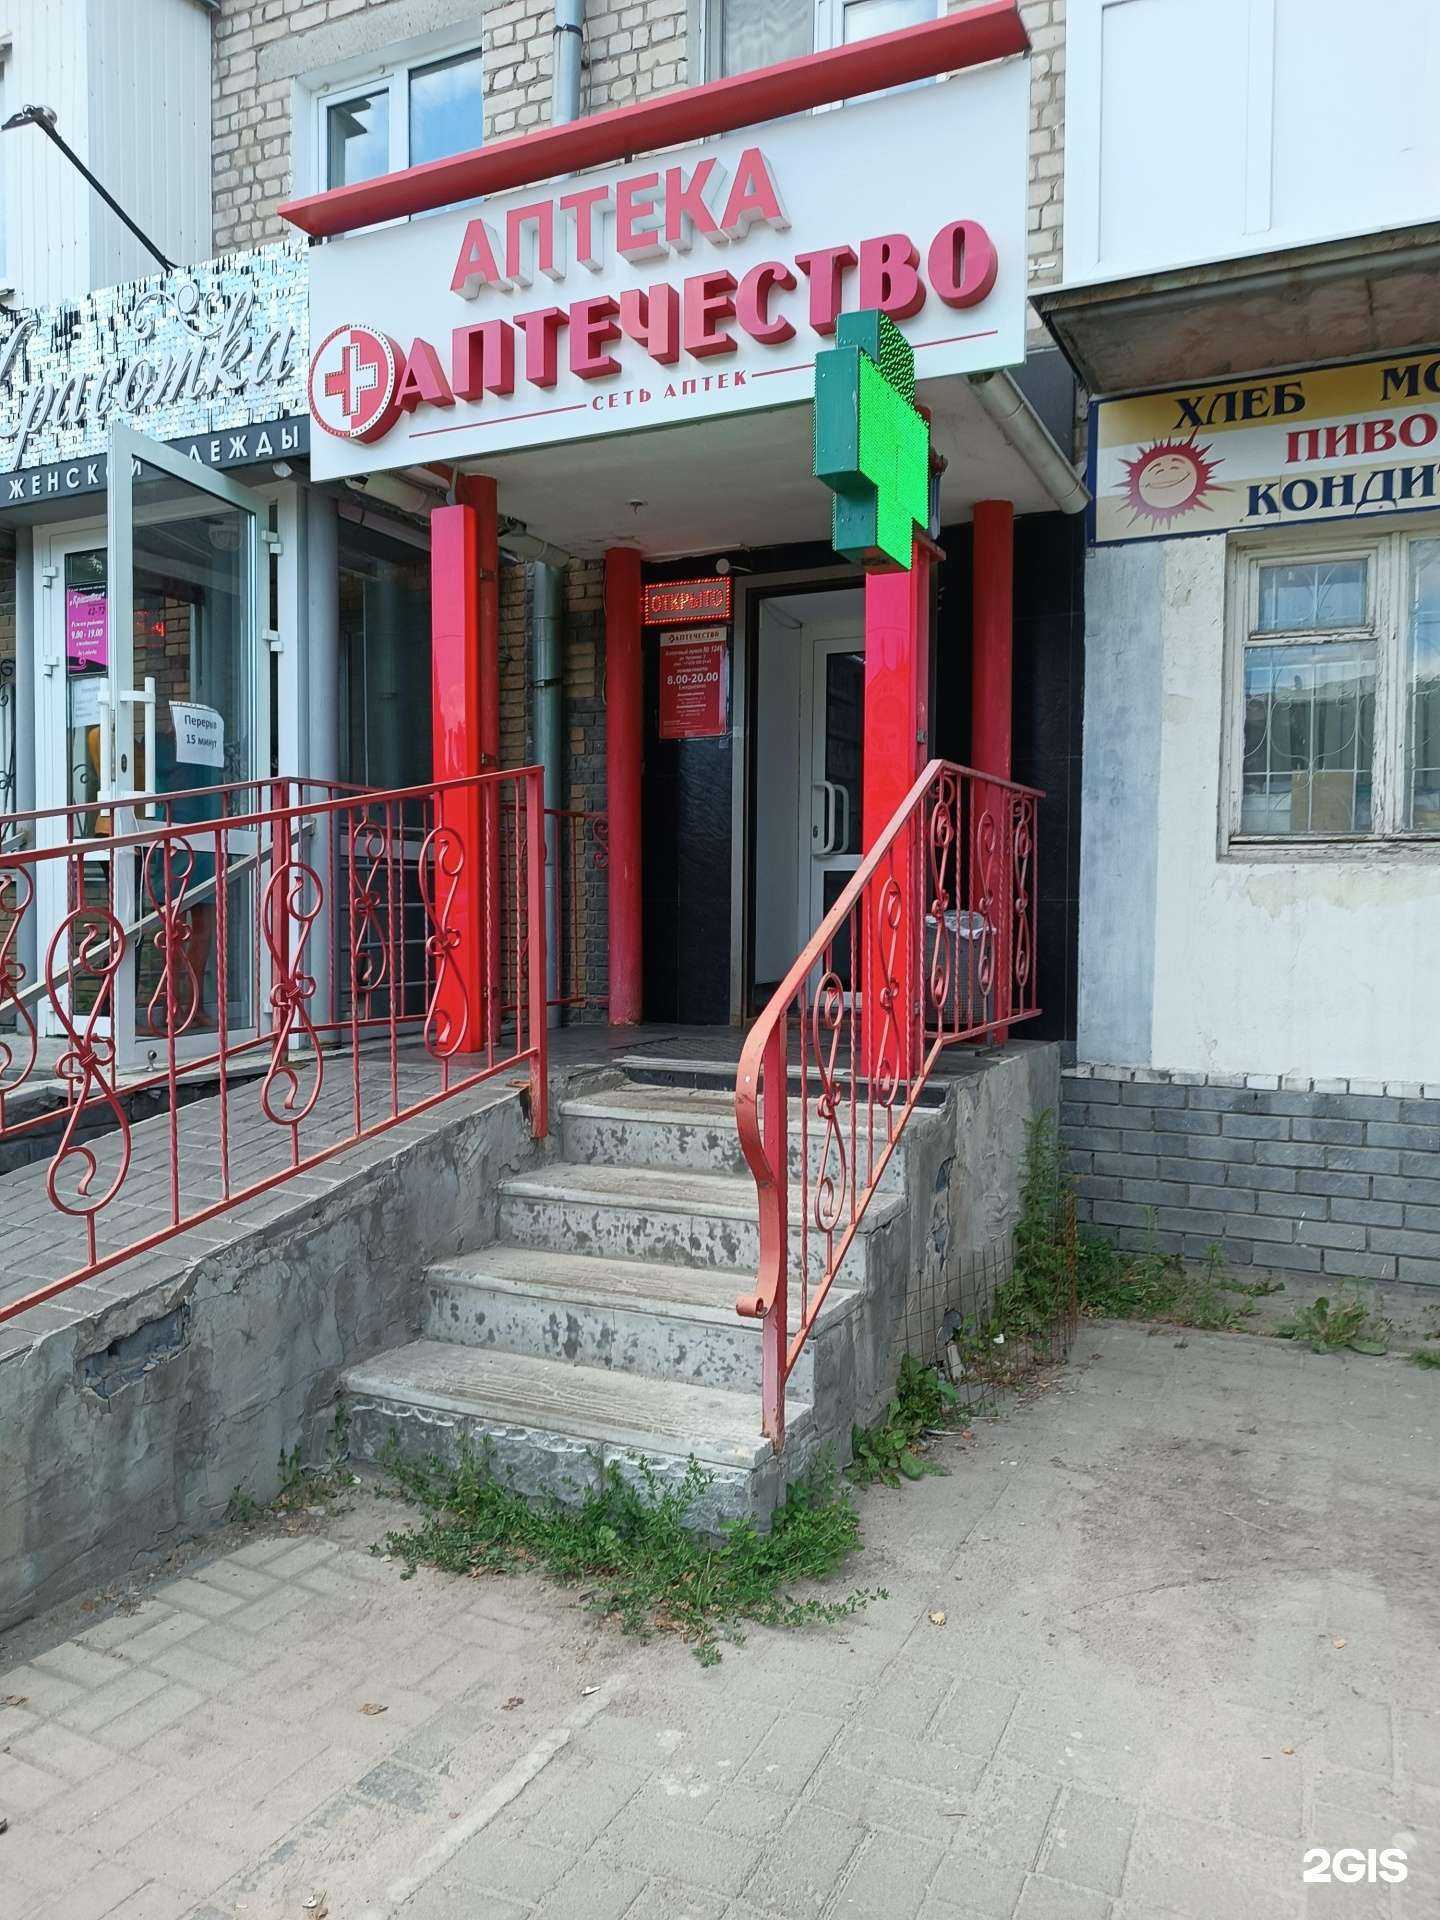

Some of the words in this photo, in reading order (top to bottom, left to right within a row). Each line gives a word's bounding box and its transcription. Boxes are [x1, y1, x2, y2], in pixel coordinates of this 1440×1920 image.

[450, 147, 791, 300] АПТЕКА
[395, 219, 998, 415] АПТЕЧЕСТВО
[593, 391, 651, 411] СЕТЬ
[664, 370, 747, 400] АПТЕК
[1172, 382, 1305, 430] ХЛЕБ
[1285, 413, 1437, 463] ПИВО
[652, 589, 722, 612] ОТКРЫТО
[667, 672, 718, 685] 8.00-20.00
[186, 734, 196, 744] 15
[198, 737, 216, 749] минут
